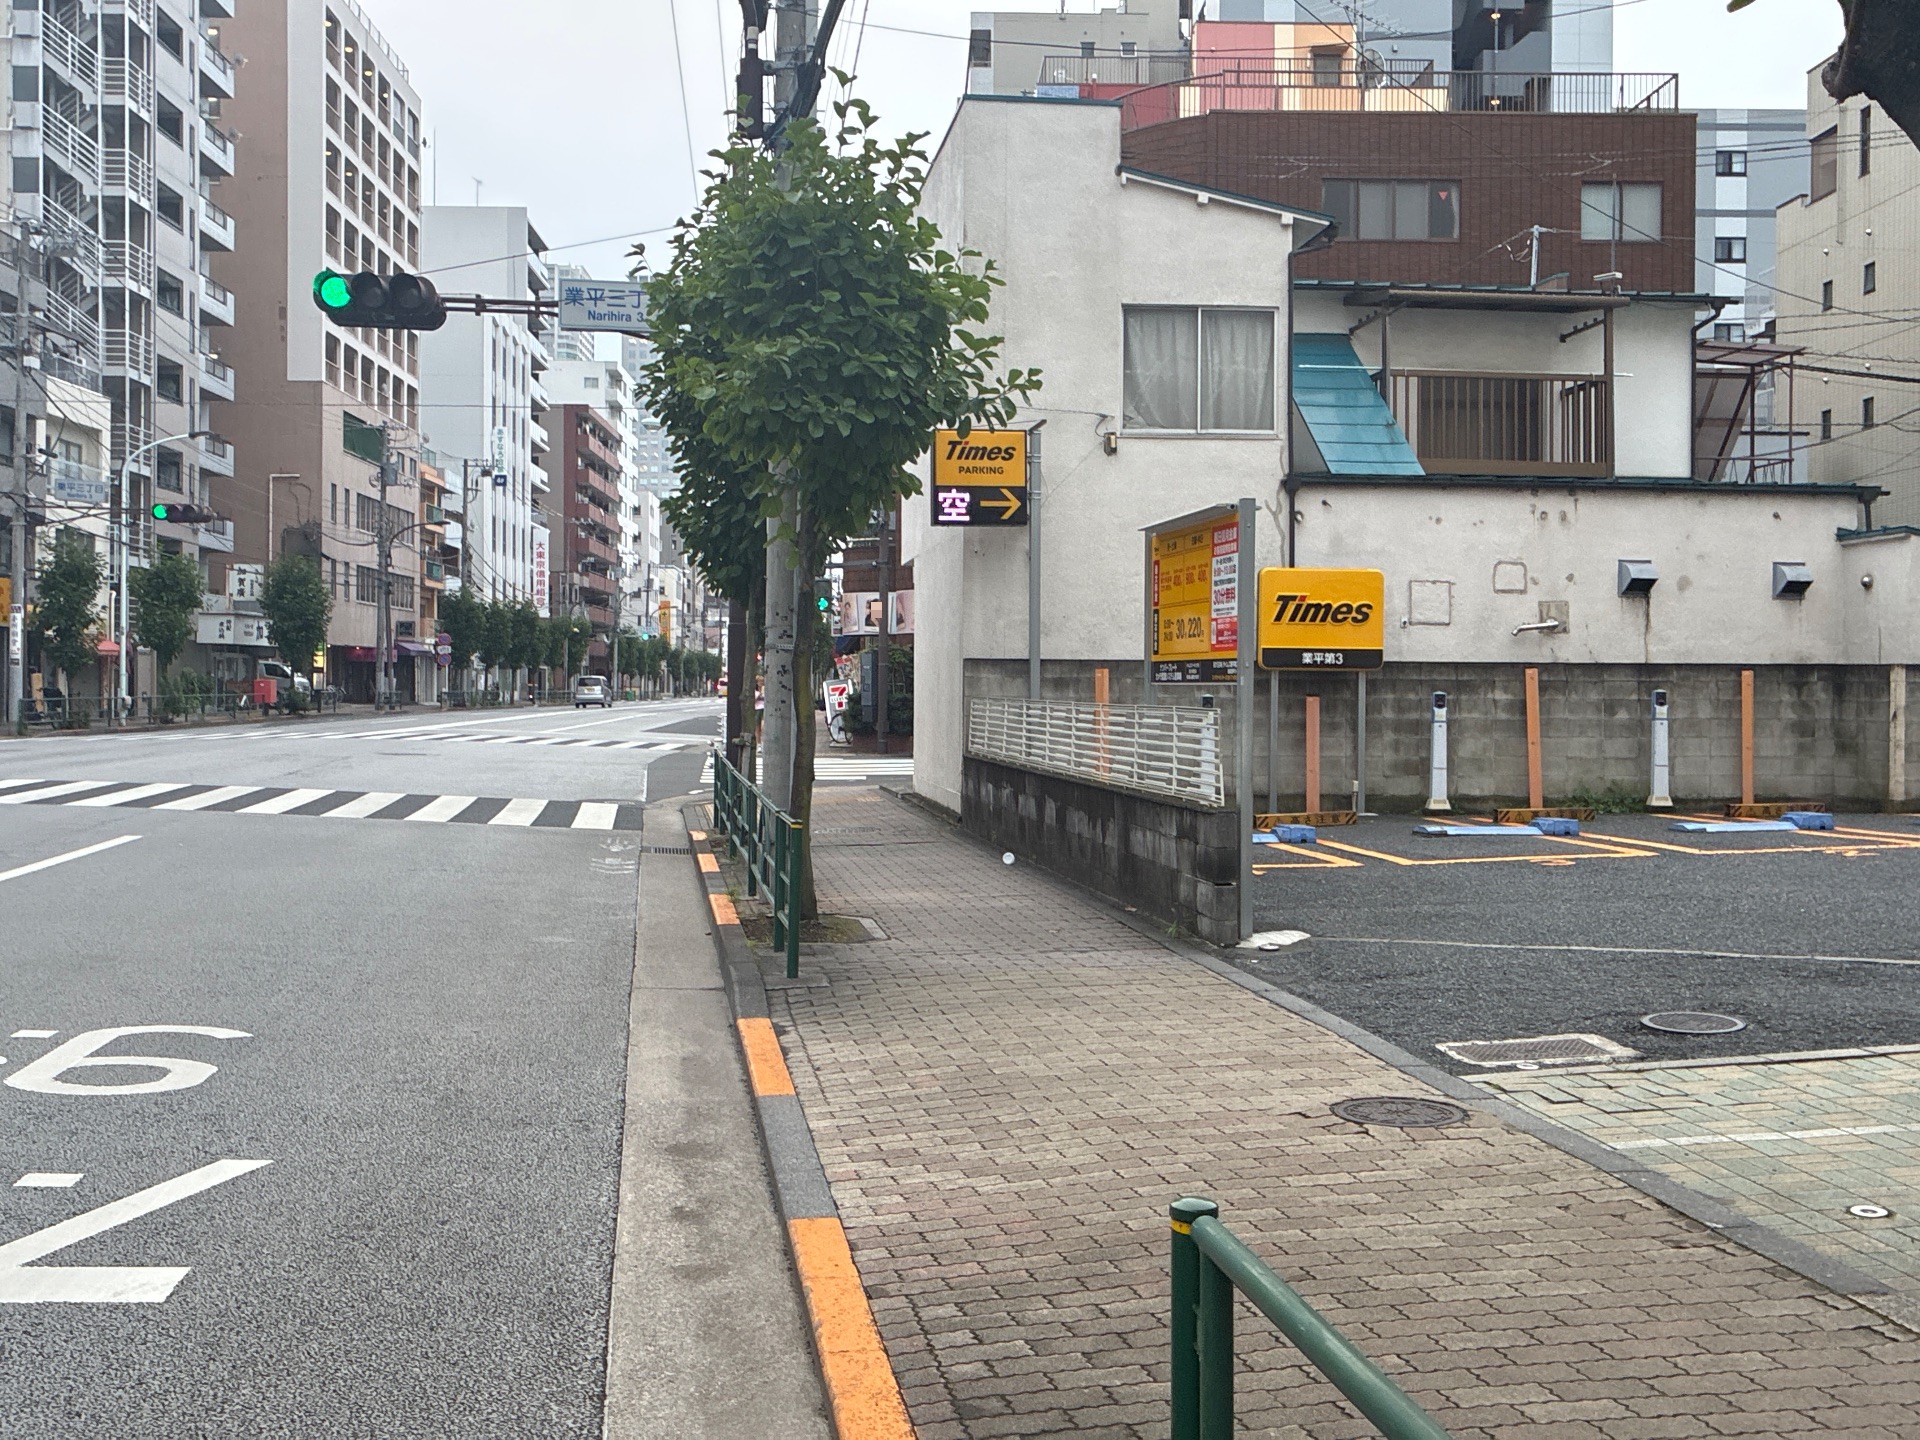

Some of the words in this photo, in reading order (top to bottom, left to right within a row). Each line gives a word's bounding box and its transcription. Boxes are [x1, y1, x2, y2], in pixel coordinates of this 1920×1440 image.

[588, 310, 632, 322] Narihira
[637, 312, 644, 322] 3
[946, 440, 1017, 461] Times
[958, 466, 1004, 475] PARKING
[938, 488, 970, 521] 空
[1273, 594, 1373, 624] Times
[1302, 652, 1344, 665] 業平第3
